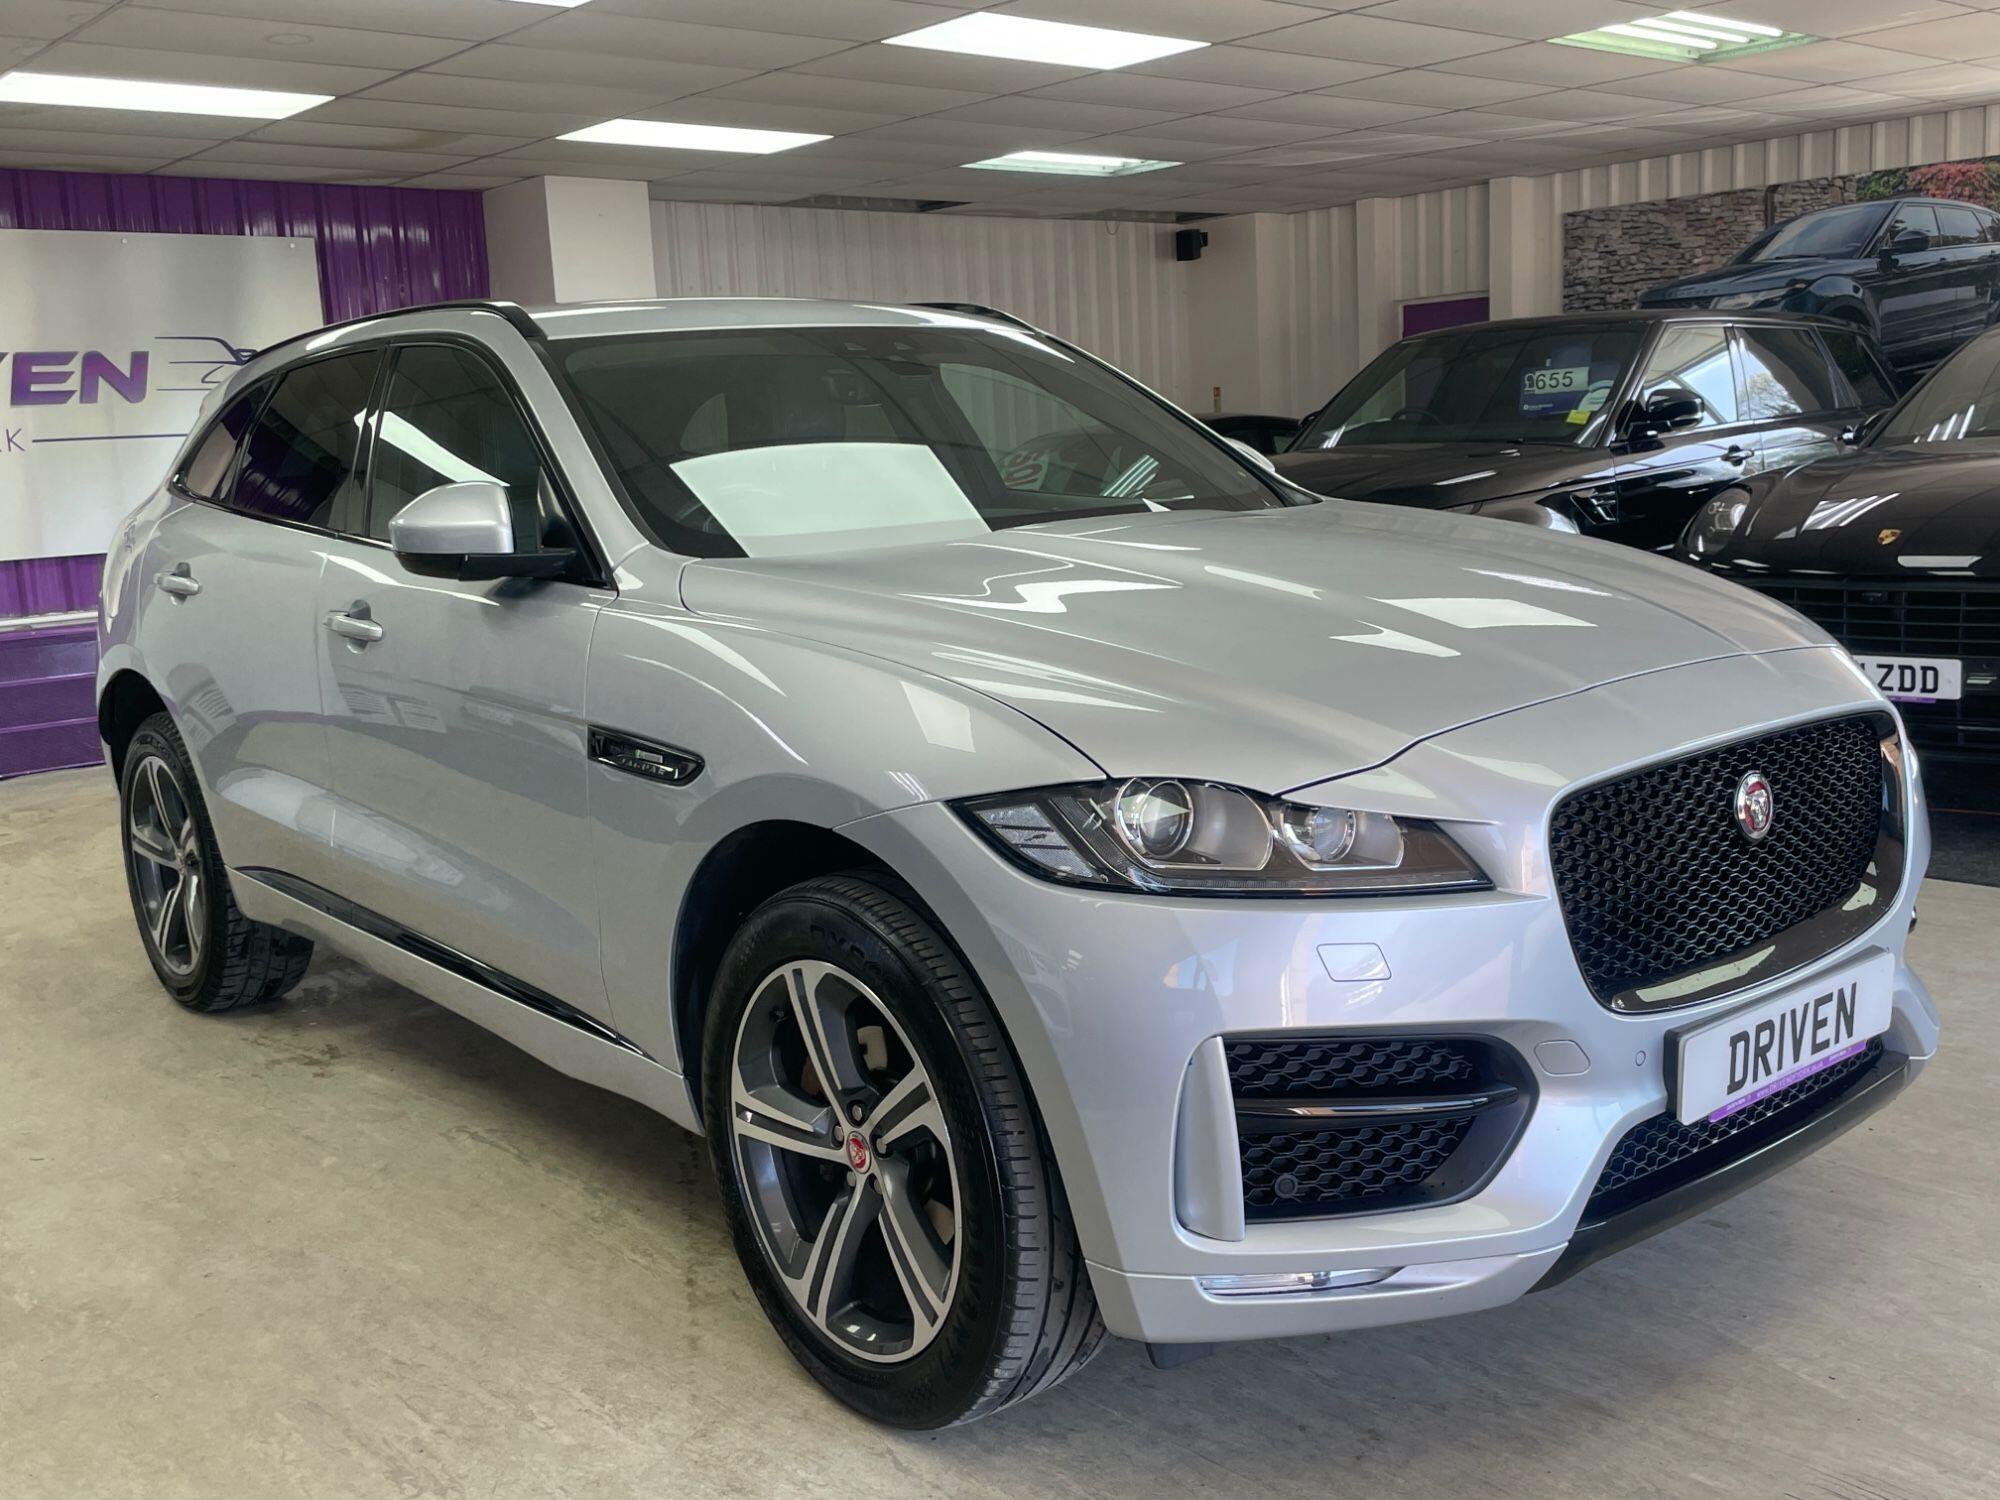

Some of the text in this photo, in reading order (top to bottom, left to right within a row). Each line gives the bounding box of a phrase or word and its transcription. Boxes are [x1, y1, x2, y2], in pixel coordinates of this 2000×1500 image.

[0, 350, 149, 406] EN
[0, 428, 25, 452] K
[1877, 663, 1939, 693] ZDD
[1727, 981, 1857, 1095] DRIVEN
